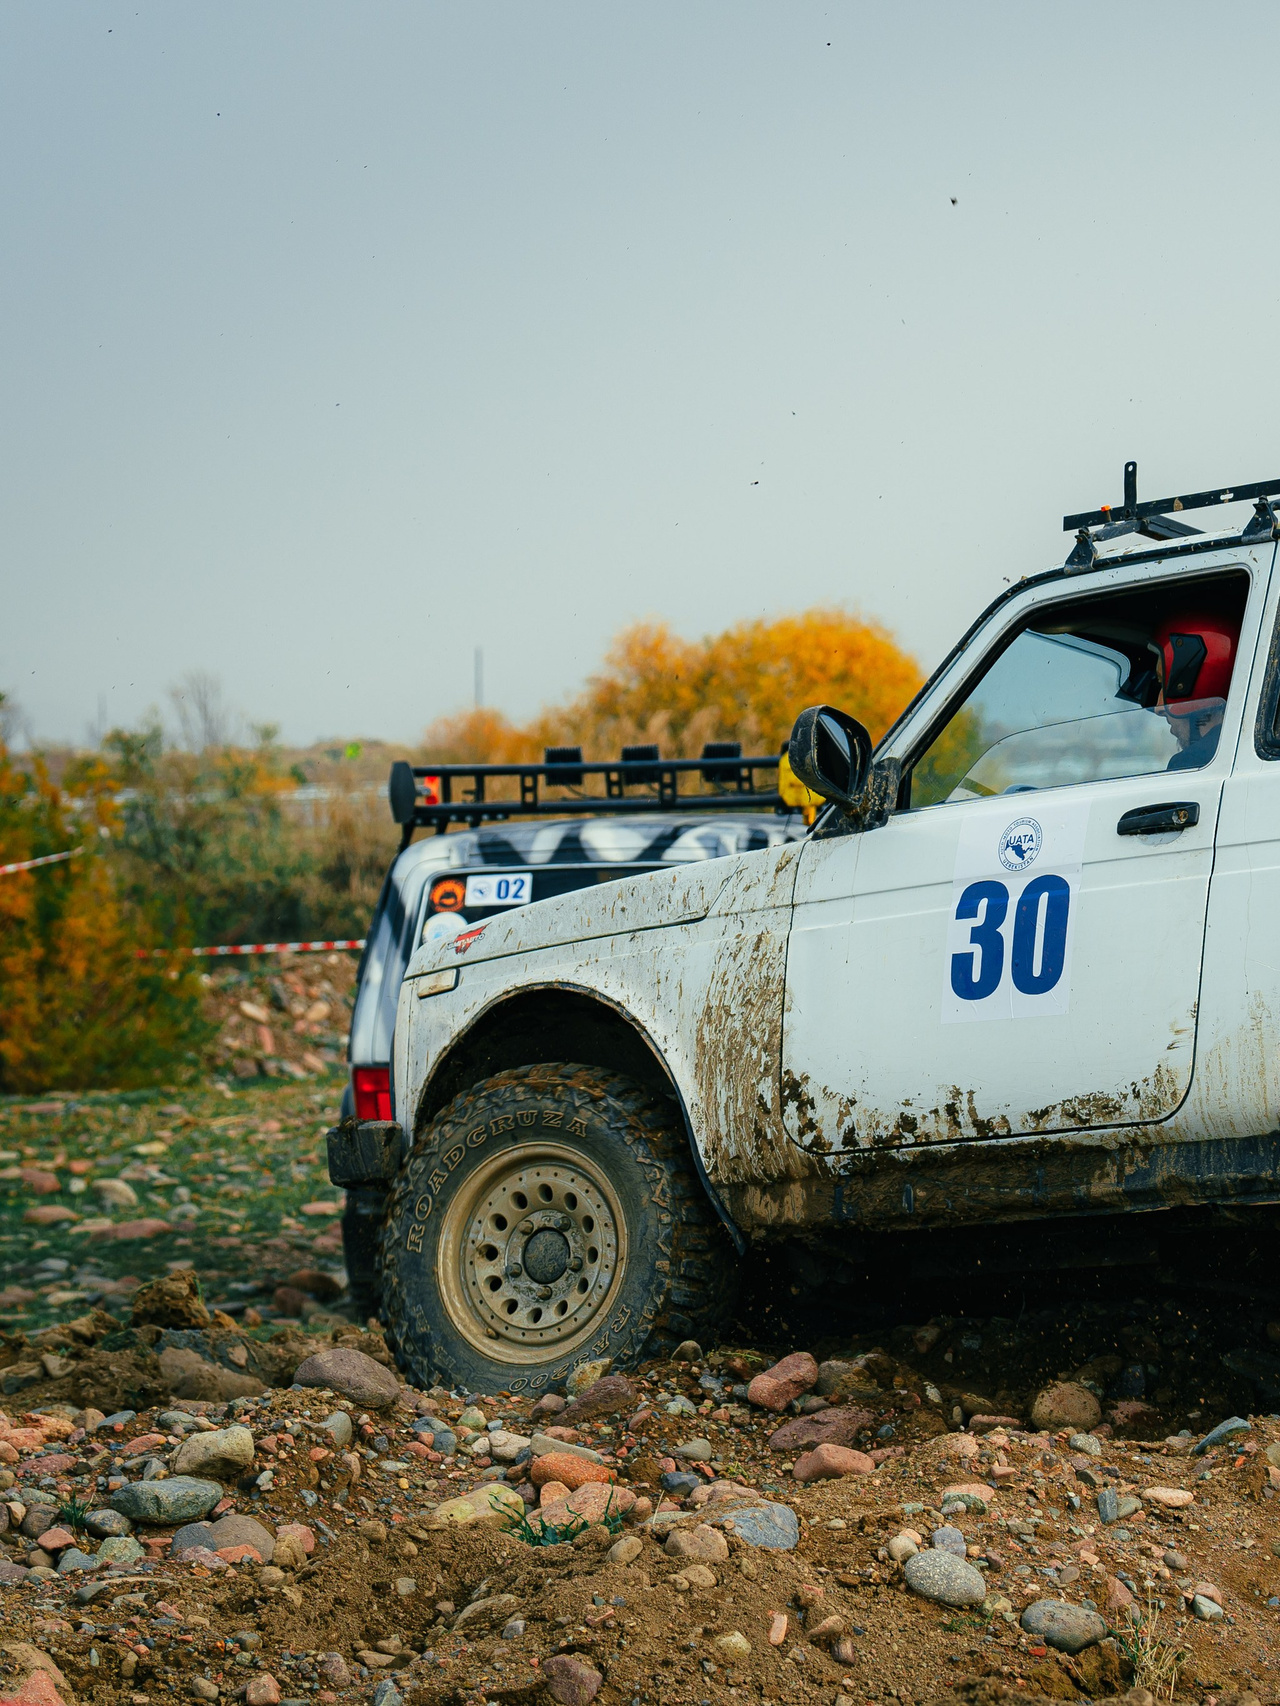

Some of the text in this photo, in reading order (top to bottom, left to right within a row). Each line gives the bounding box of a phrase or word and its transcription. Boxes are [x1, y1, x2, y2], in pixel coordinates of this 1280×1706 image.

[1008, 833, 1035, 846] UATA
[496, 878, 525, 900] 02
[950, 874, 1071, 1001] 30
[407, 1110, 588, 1253] ROADCRUZA
